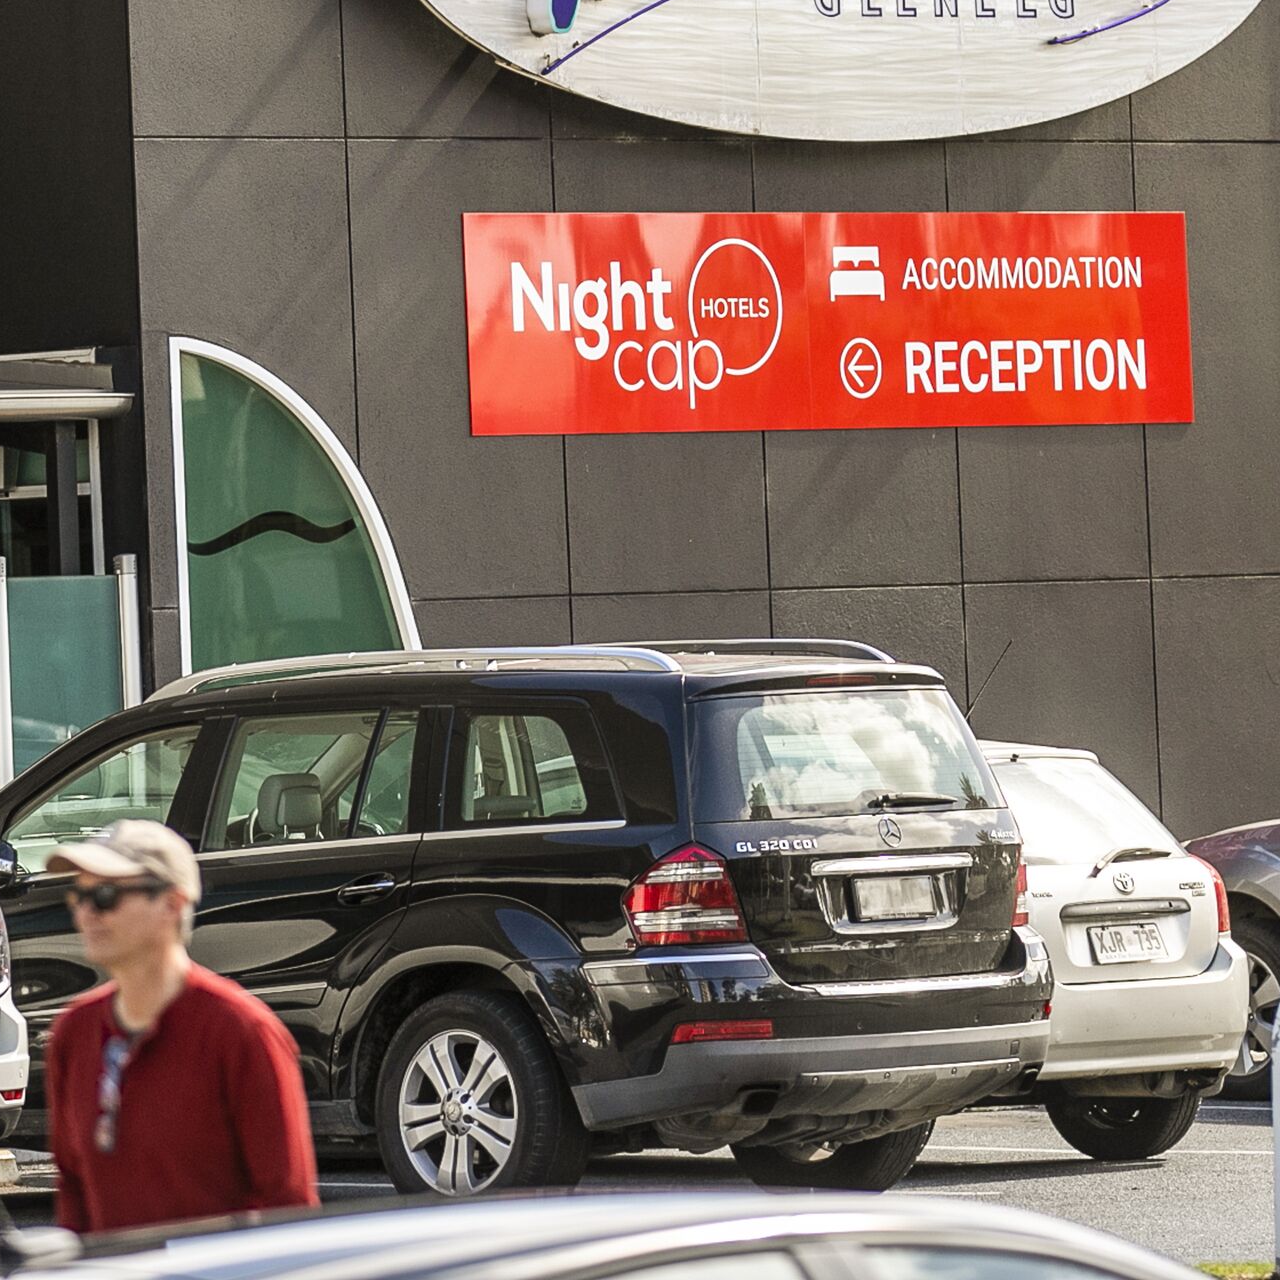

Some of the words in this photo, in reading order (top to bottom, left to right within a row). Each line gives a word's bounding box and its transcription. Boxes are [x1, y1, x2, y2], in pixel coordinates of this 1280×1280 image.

[902, 256, 1144, 291] ACCOMMODATION
[511, 261, 675, 361] Night
[700, 297, 770, 319] HOTELS
[613, 339, 725, 410] cap
[905, 338, 1148, 394] RECEPTION
[735, 841, 757, 853] GL
[759, 839, 790, 851] 320
[793, 838, 819, 850] CDI
[1095, 928, 1128, 954] XJR
[1132, 927, 1163, 952] 735
